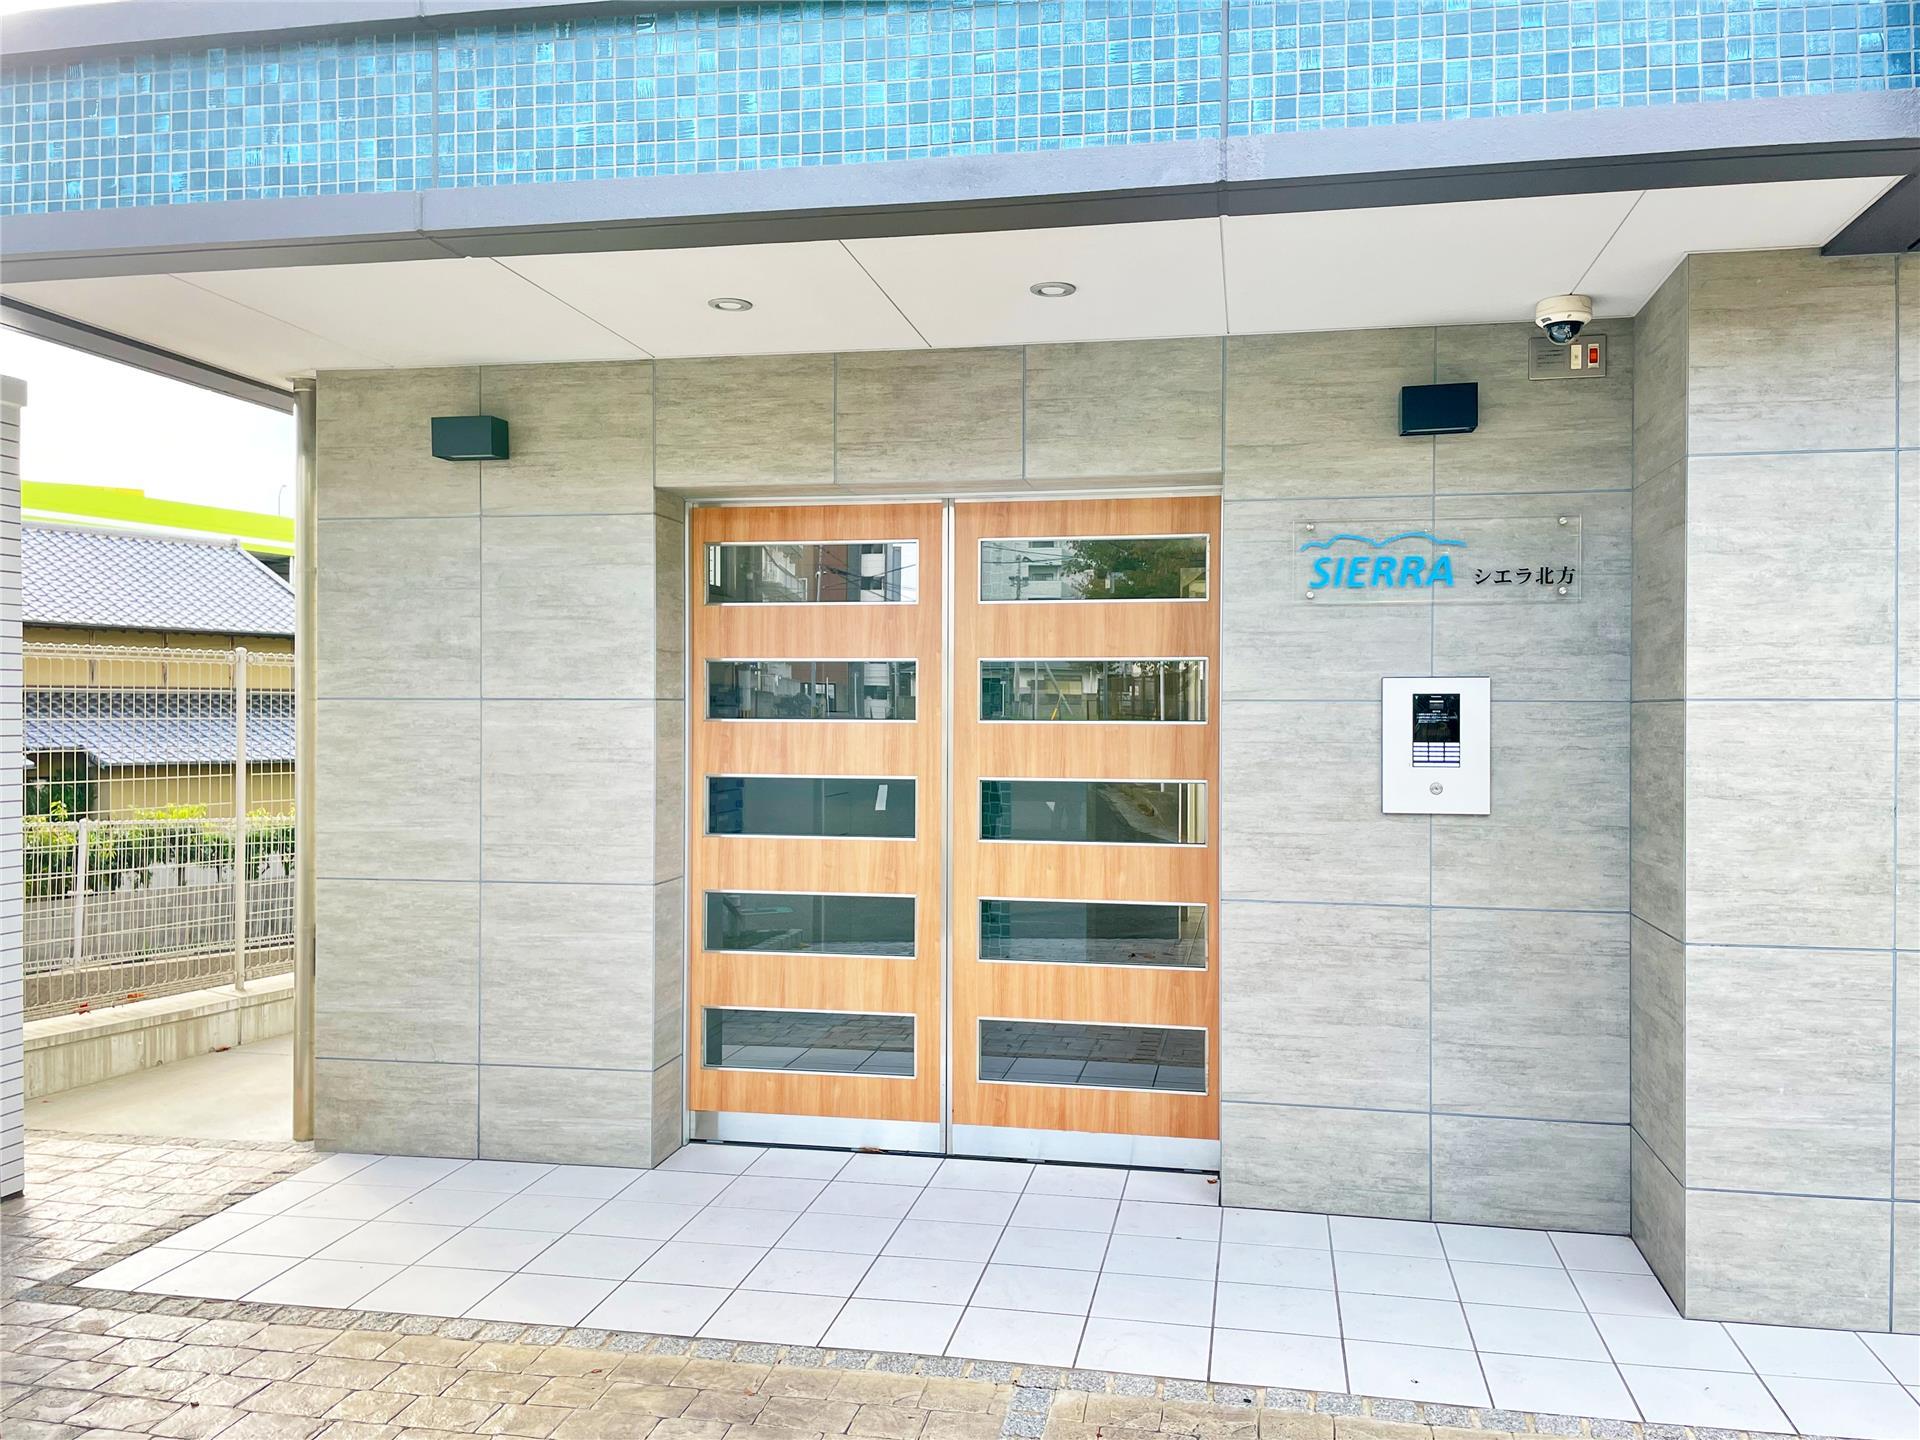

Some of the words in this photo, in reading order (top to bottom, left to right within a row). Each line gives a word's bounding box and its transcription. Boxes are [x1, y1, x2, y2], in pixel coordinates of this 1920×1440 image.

[1309, 554, 1454, 588] SIERRA
[1474, 566, 1575, 585] シエラ北方
